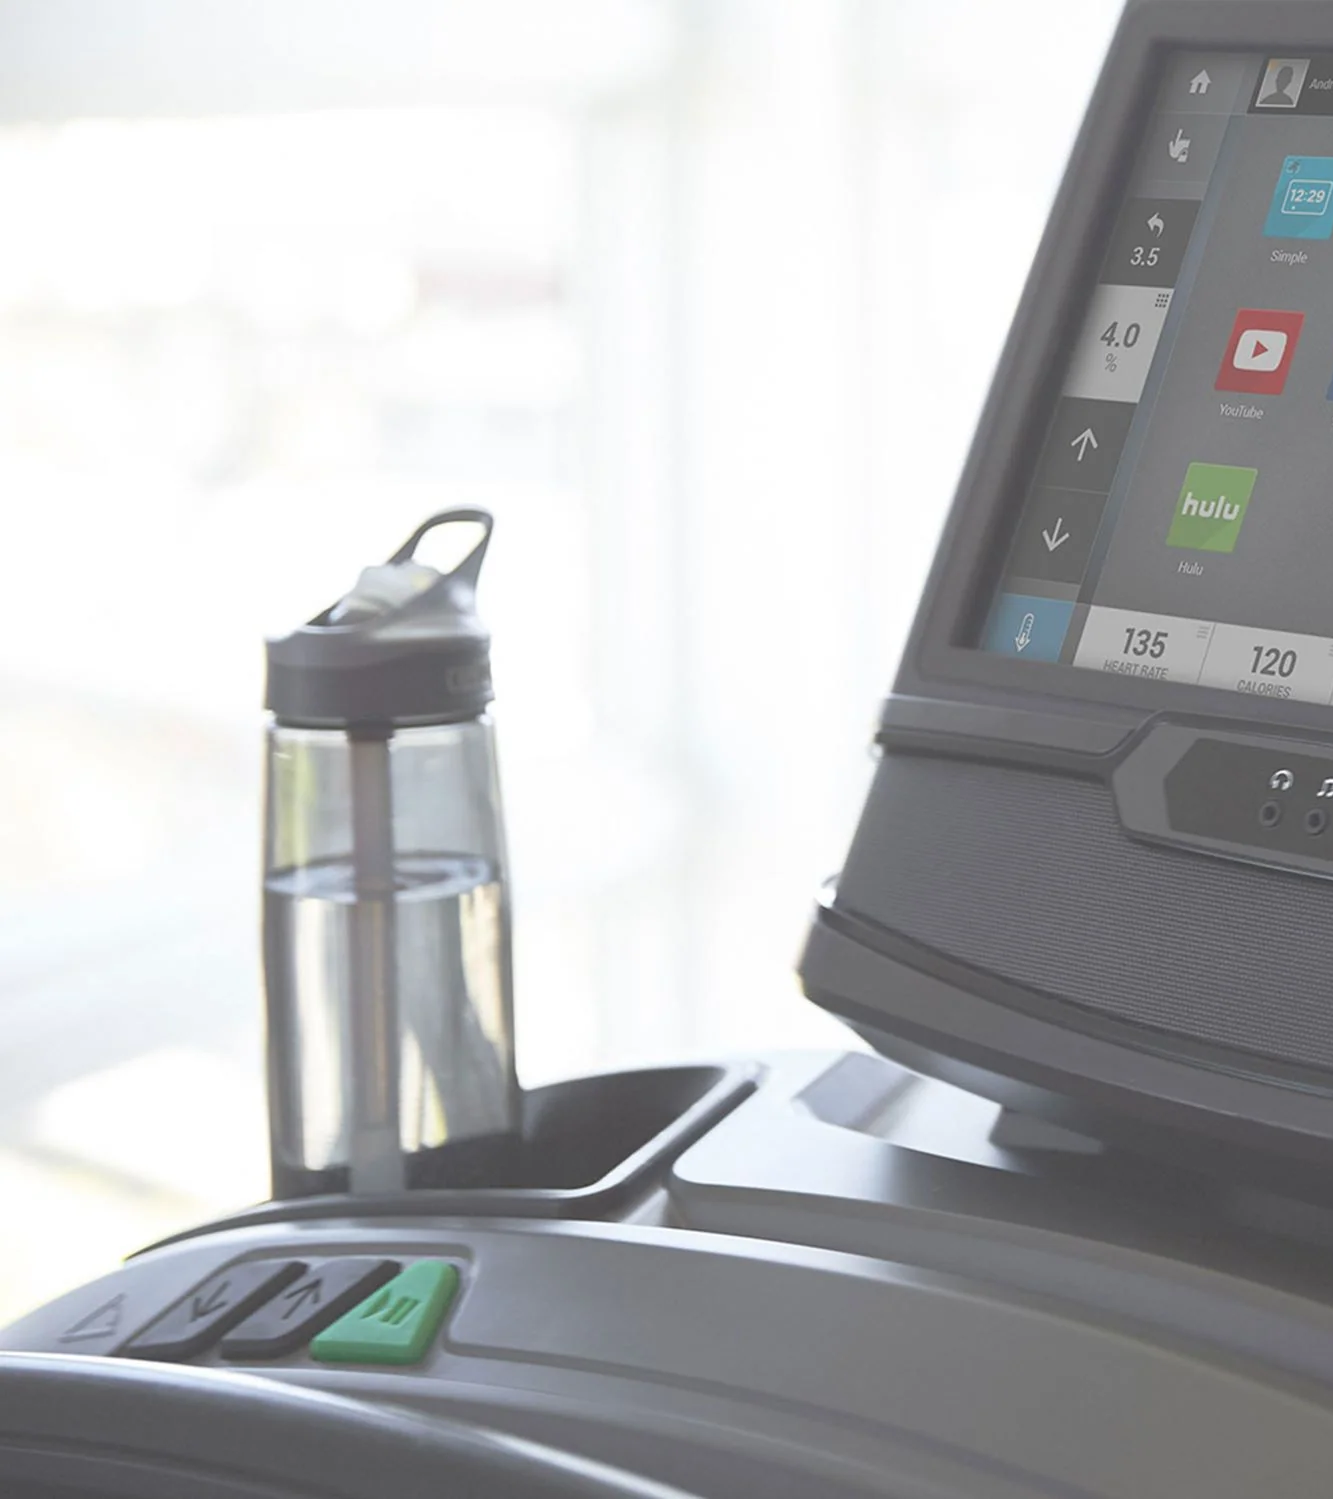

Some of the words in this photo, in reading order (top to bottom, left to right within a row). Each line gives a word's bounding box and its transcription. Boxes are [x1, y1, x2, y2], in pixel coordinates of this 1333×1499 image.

[1289, 187, 1326, 205] 12:29
[1130, 246, 1160, 267] 3.5
[1270, 249, 1308, 266] Simple
[1100, 322, 1141, 348] 4.0
[1104, 352, 1118, 372] %
[1219, 403, 1264, 420] YouTube
[1181, 492, 1240, 521] hulu
[1178, 561, 1204, 576] Hulu
[1121, 627, 1168, 659] 135
[1104, 660, 1139, 675] HEART
[1141, 664, 1168, 679] RATE
[1251, 646, 1297, 678] 120
[1237, 680, 1292, 698] CALORIES
